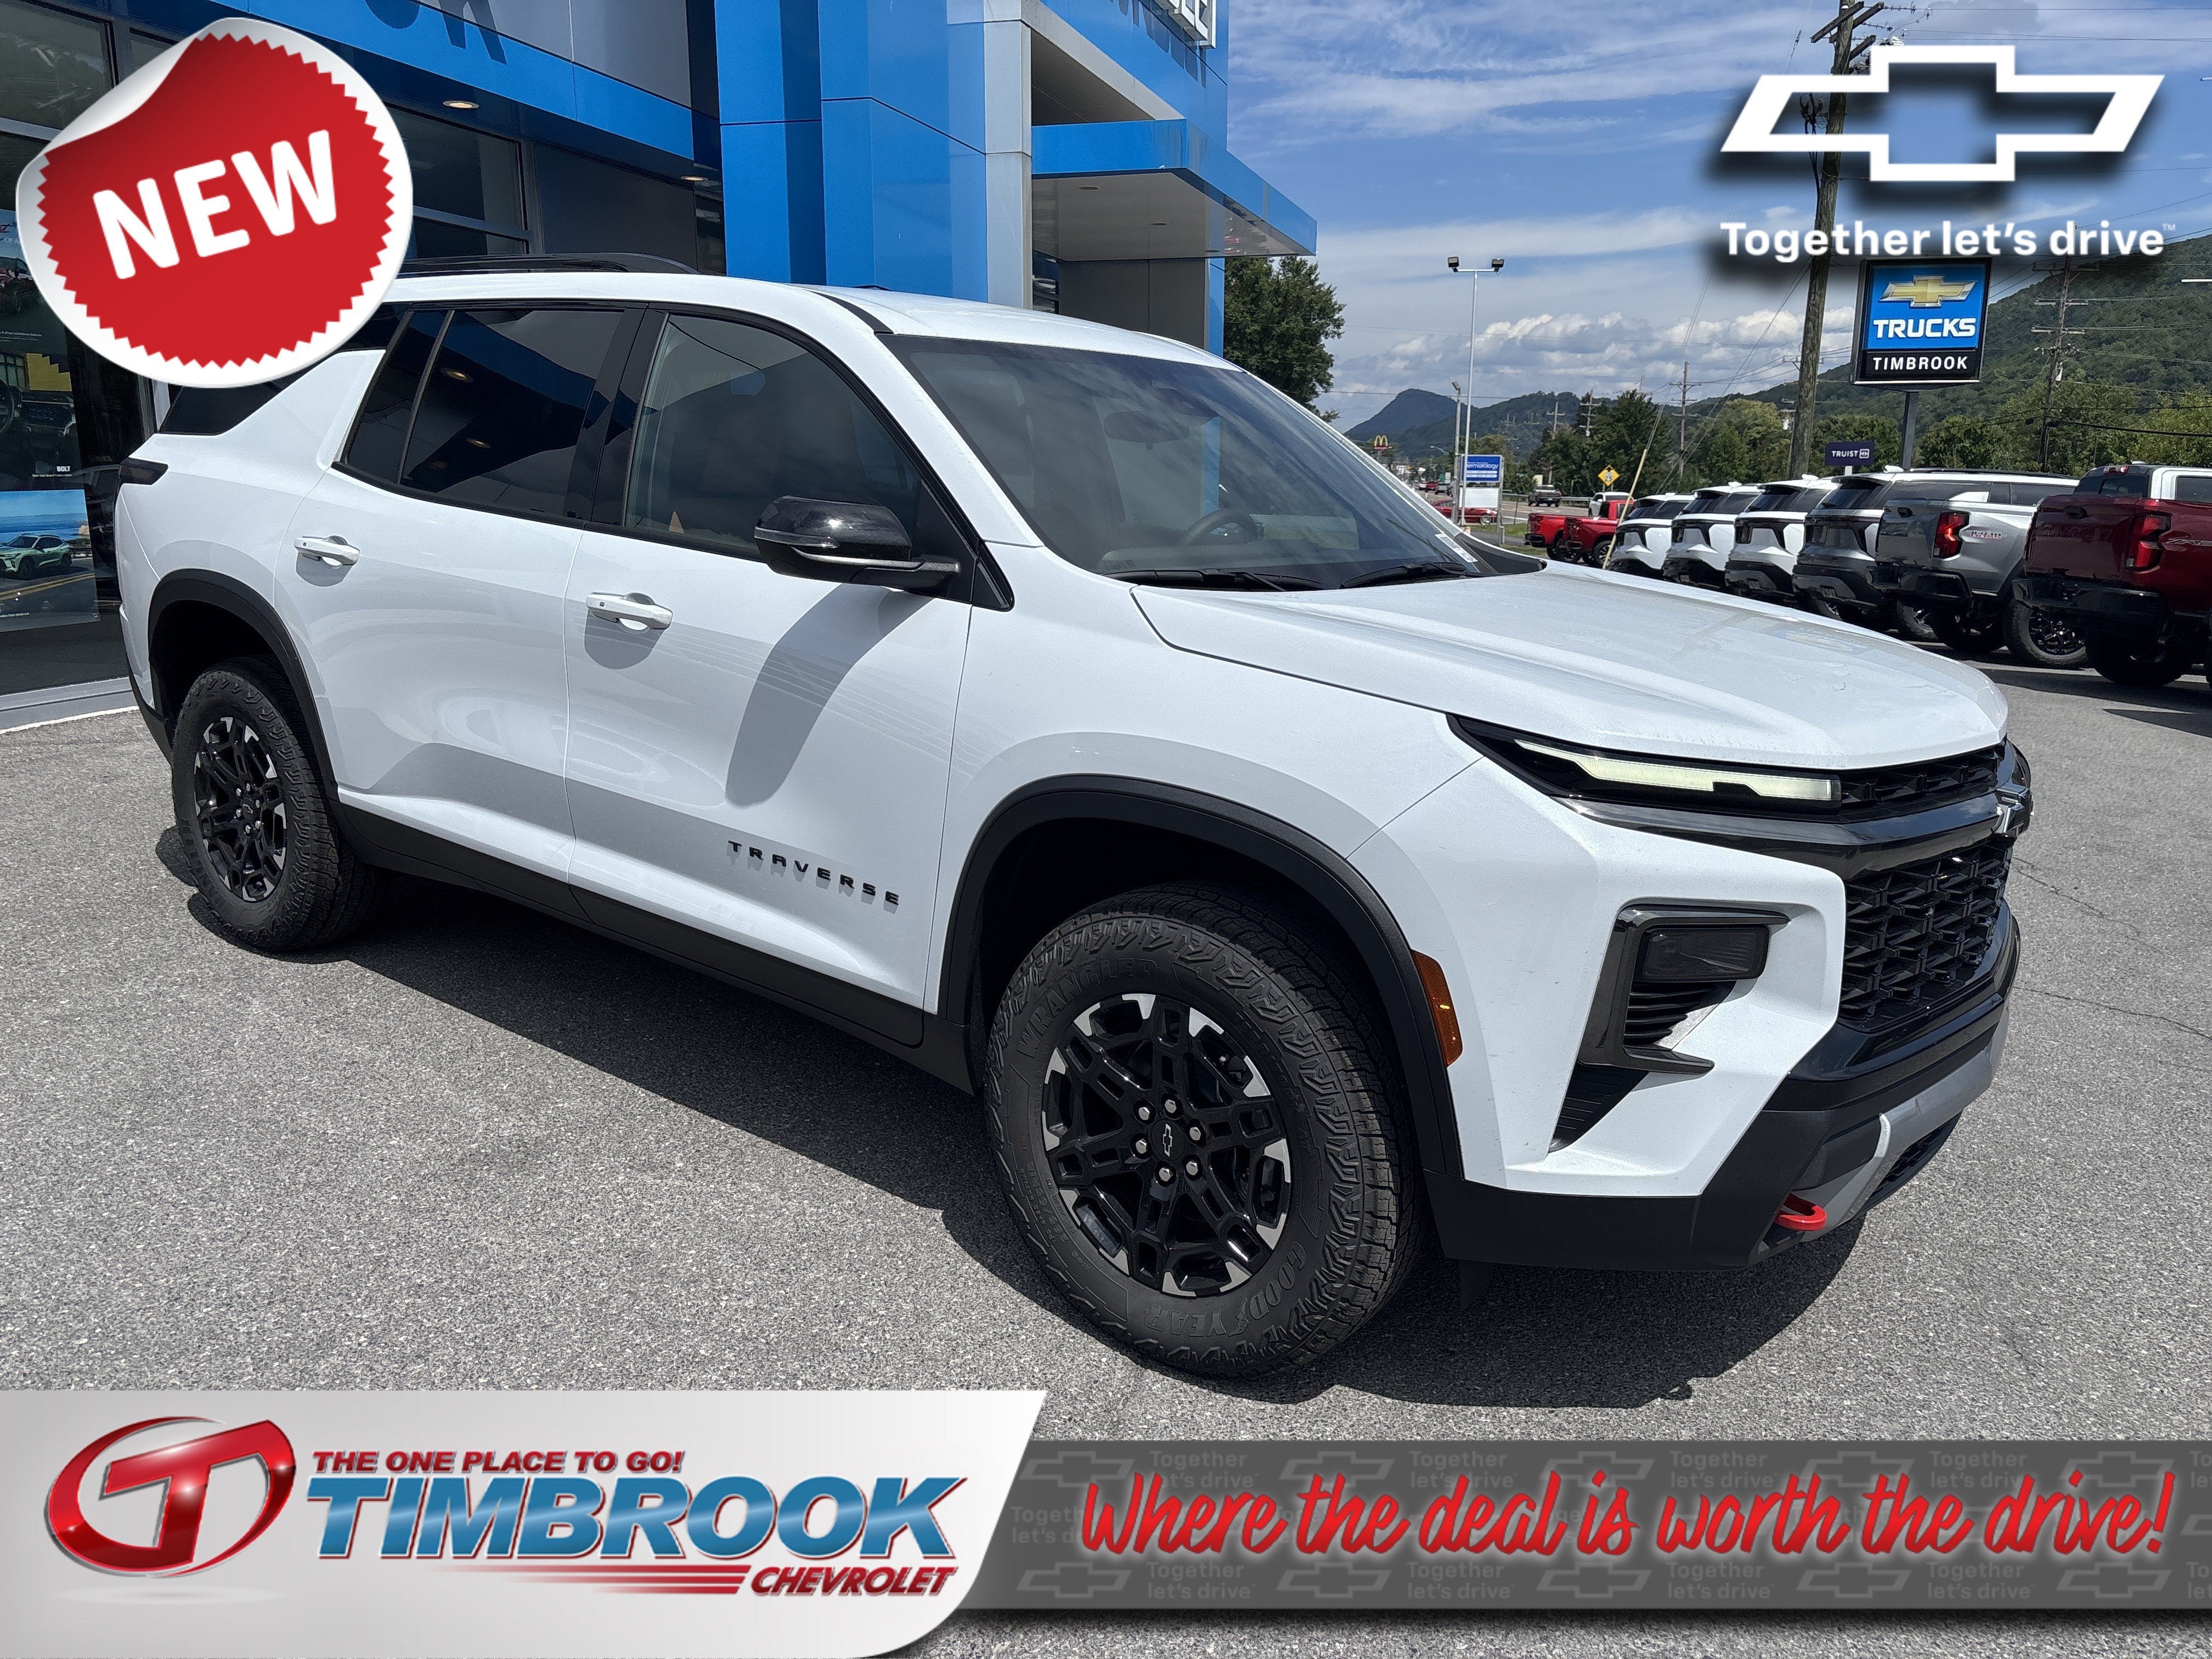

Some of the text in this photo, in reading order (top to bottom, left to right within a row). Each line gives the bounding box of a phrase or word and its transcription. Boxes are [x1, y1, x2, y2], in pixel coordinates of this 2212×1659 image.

[1873, 317, 1976, 339] TRUCKS
[1873, 356, 1968, 371] TIMBROOK
[728, 840, 899, 906] TRAVERSE
[1015, 953, 1159, 1063] WRANGLER
